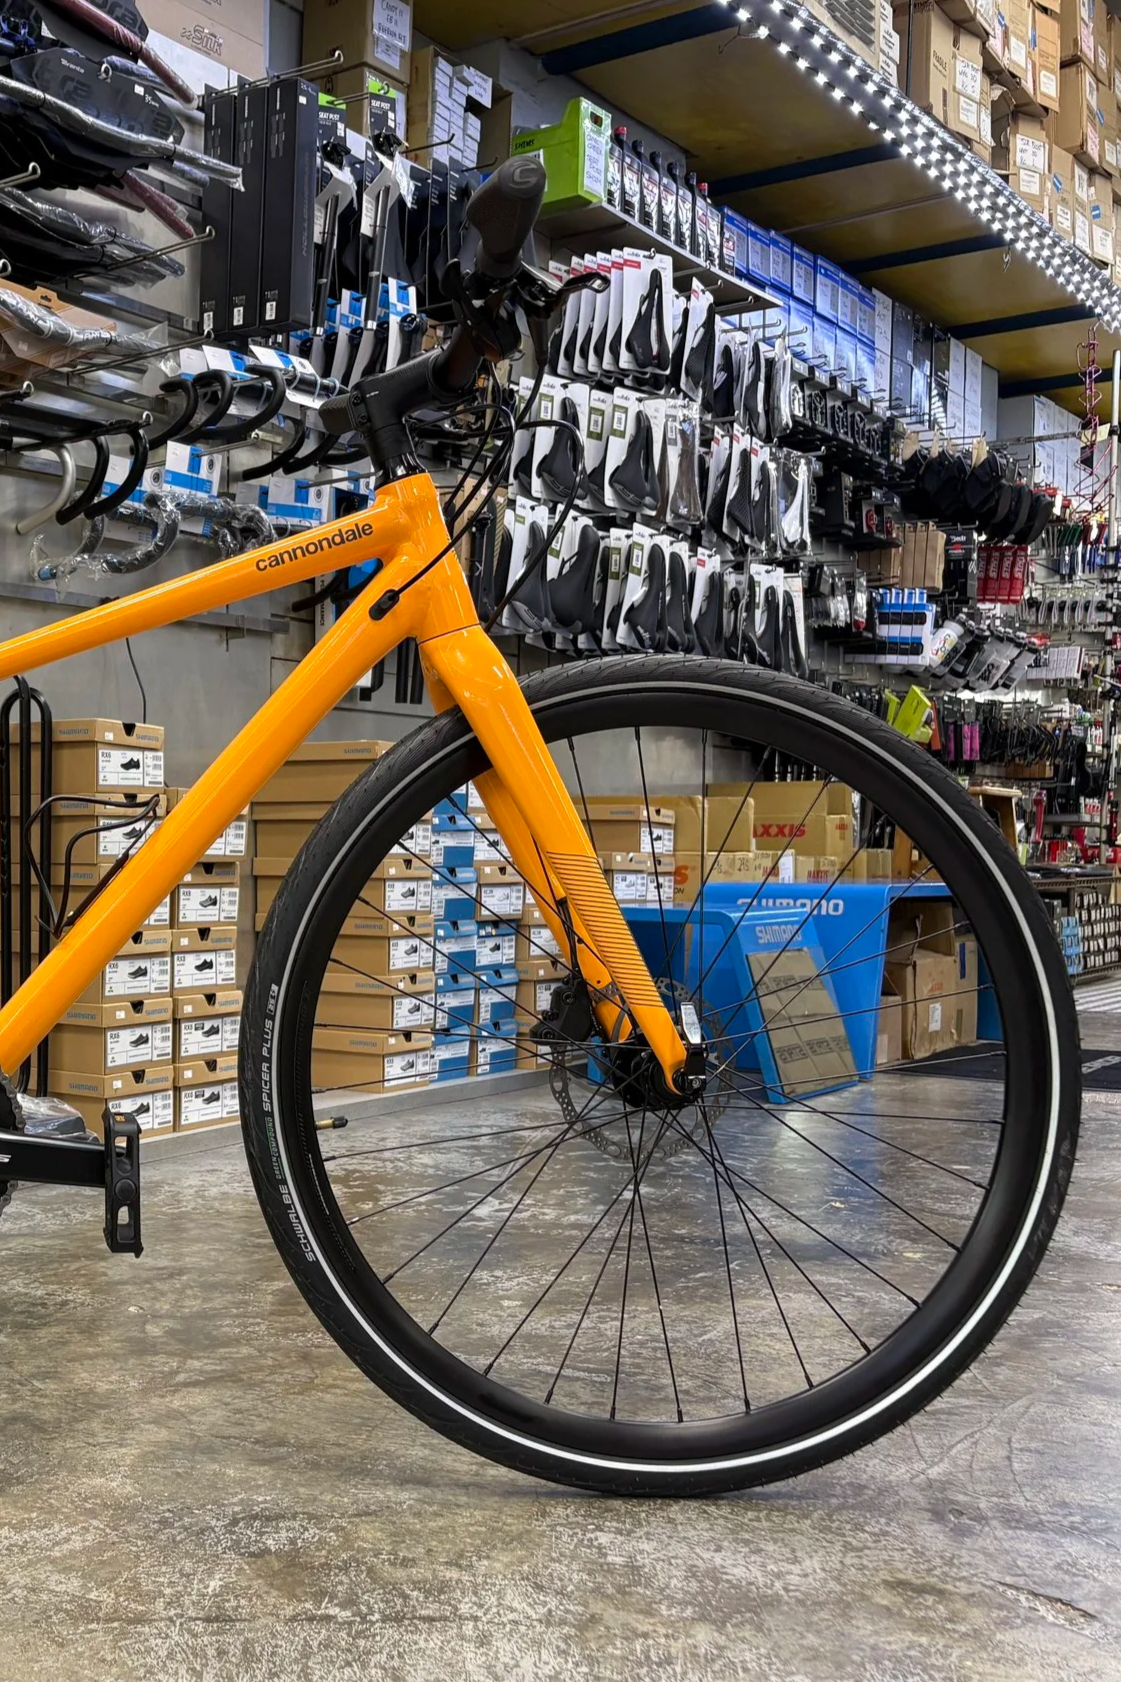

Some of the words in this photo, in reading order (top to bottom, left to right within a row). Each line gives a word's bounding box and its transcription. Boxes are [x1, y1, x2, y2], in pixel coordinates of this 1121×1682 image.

[318, 111, 328, 120] SEAT
[370, 99, 380, 108] SEAT
[380, 101, 391, 110] POST
[255, 522, 374, 572] cannondale
[101, 751, 111, 759] RX6
[755, 925, 803, 944] SHIMANO
[262, 1018, 274, 1058] PLUS
[68, 1083, 99, 1092] SHIMANO
[261, 1060, 273, 1113] SPICER
[267, 1116, 278, 1157] COMPOUND
[272, 1156, 282, 1180] GREEN
[279, 1184, 316, 1262] SCHWALBE
